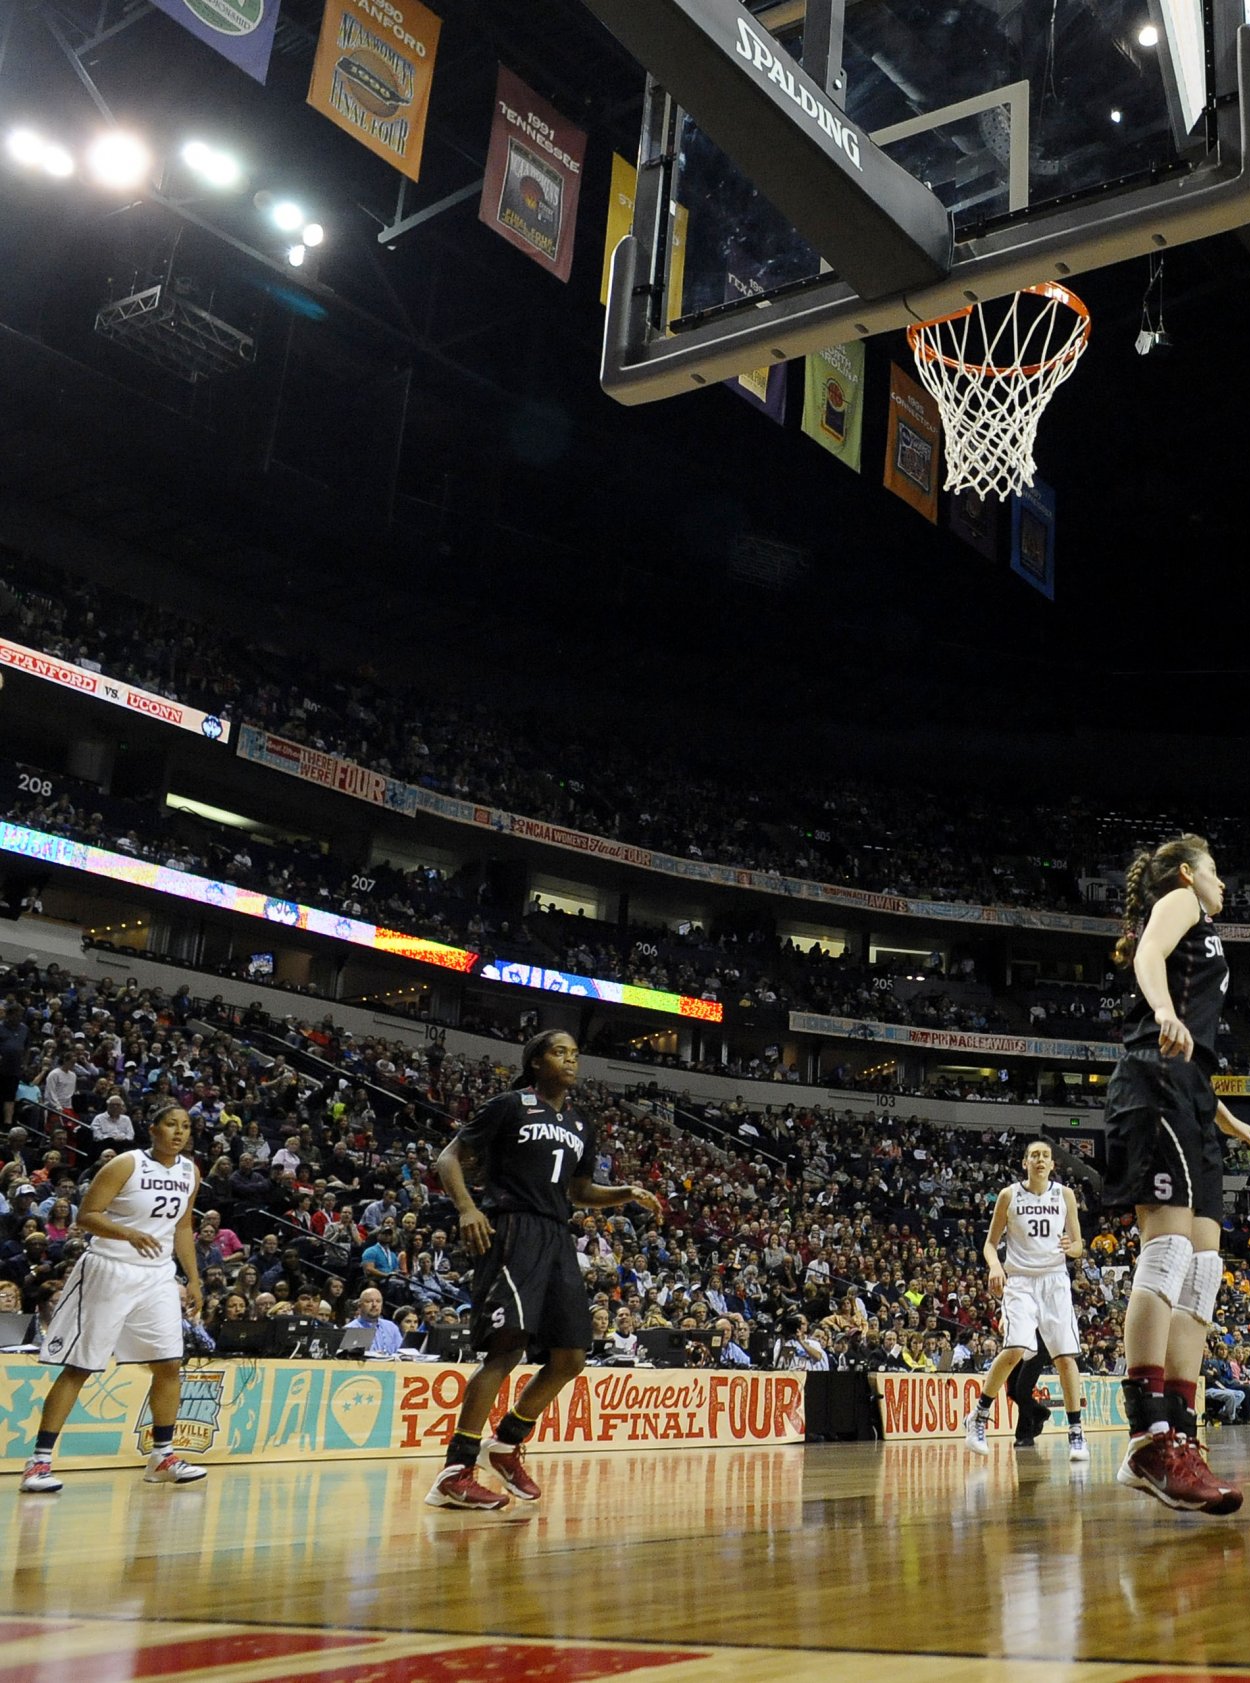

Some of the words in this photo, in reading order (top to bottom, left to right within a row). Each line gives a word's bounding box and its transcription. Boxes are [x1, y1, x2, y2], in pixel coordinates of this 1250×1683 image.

[350, 65, 391, 99] 1990
[736, 17, 863, 171] SPALDING
[329, 70, 368, 132] FINAL
[370, 117, 409, 158] FOUR
[527, 111, 555, 140] 1991
[499, 101, 580, 173] TENNESSEE
[0, 648, 95, 692] STANFORD
[129, 695, 183, 723] UCONN
[301, 749, 333, 771] THERE
[18, 774, 52, 797] 208
[300, 763, 332, 785] WERE
[336, 761, 386, 805] FOUR
[525, 820, 551, 841] NCAA
[621, 846, 651, 867] FOUR
[351, 875, 376, 893] 207
[867, 895, 908, 913] AWAITS
[635, 941, 658, 957] 206
[872, 976, 894, 991] 205
[424, 1025, 447, 1041] 104
[876, 1095, 896, 1108] 103
[551, 1149, 564, 1184] 1
[140, 1178, 190, 1194] UCONN
[1154, 1173, 1172, 1200] S
[150, 1196, 181, 1219] 23
[1016, 1205, 1060, 1215] UCONN
[1027, 1219, 1050, 1238] 30
[491, 1307, 505, 1328] S
[180, 1381, 219, 1399] INAL
[401, 1370, 466, 1409] 20
[595, 1373, 707, 1412] Women's
[708, 1375, 806, 1440] FOUR
[885, 1377, 958, 1434] MUSIC
[400, 1413, 455, 1448] 14
[597, 1413, 705, 1442] FINAL
